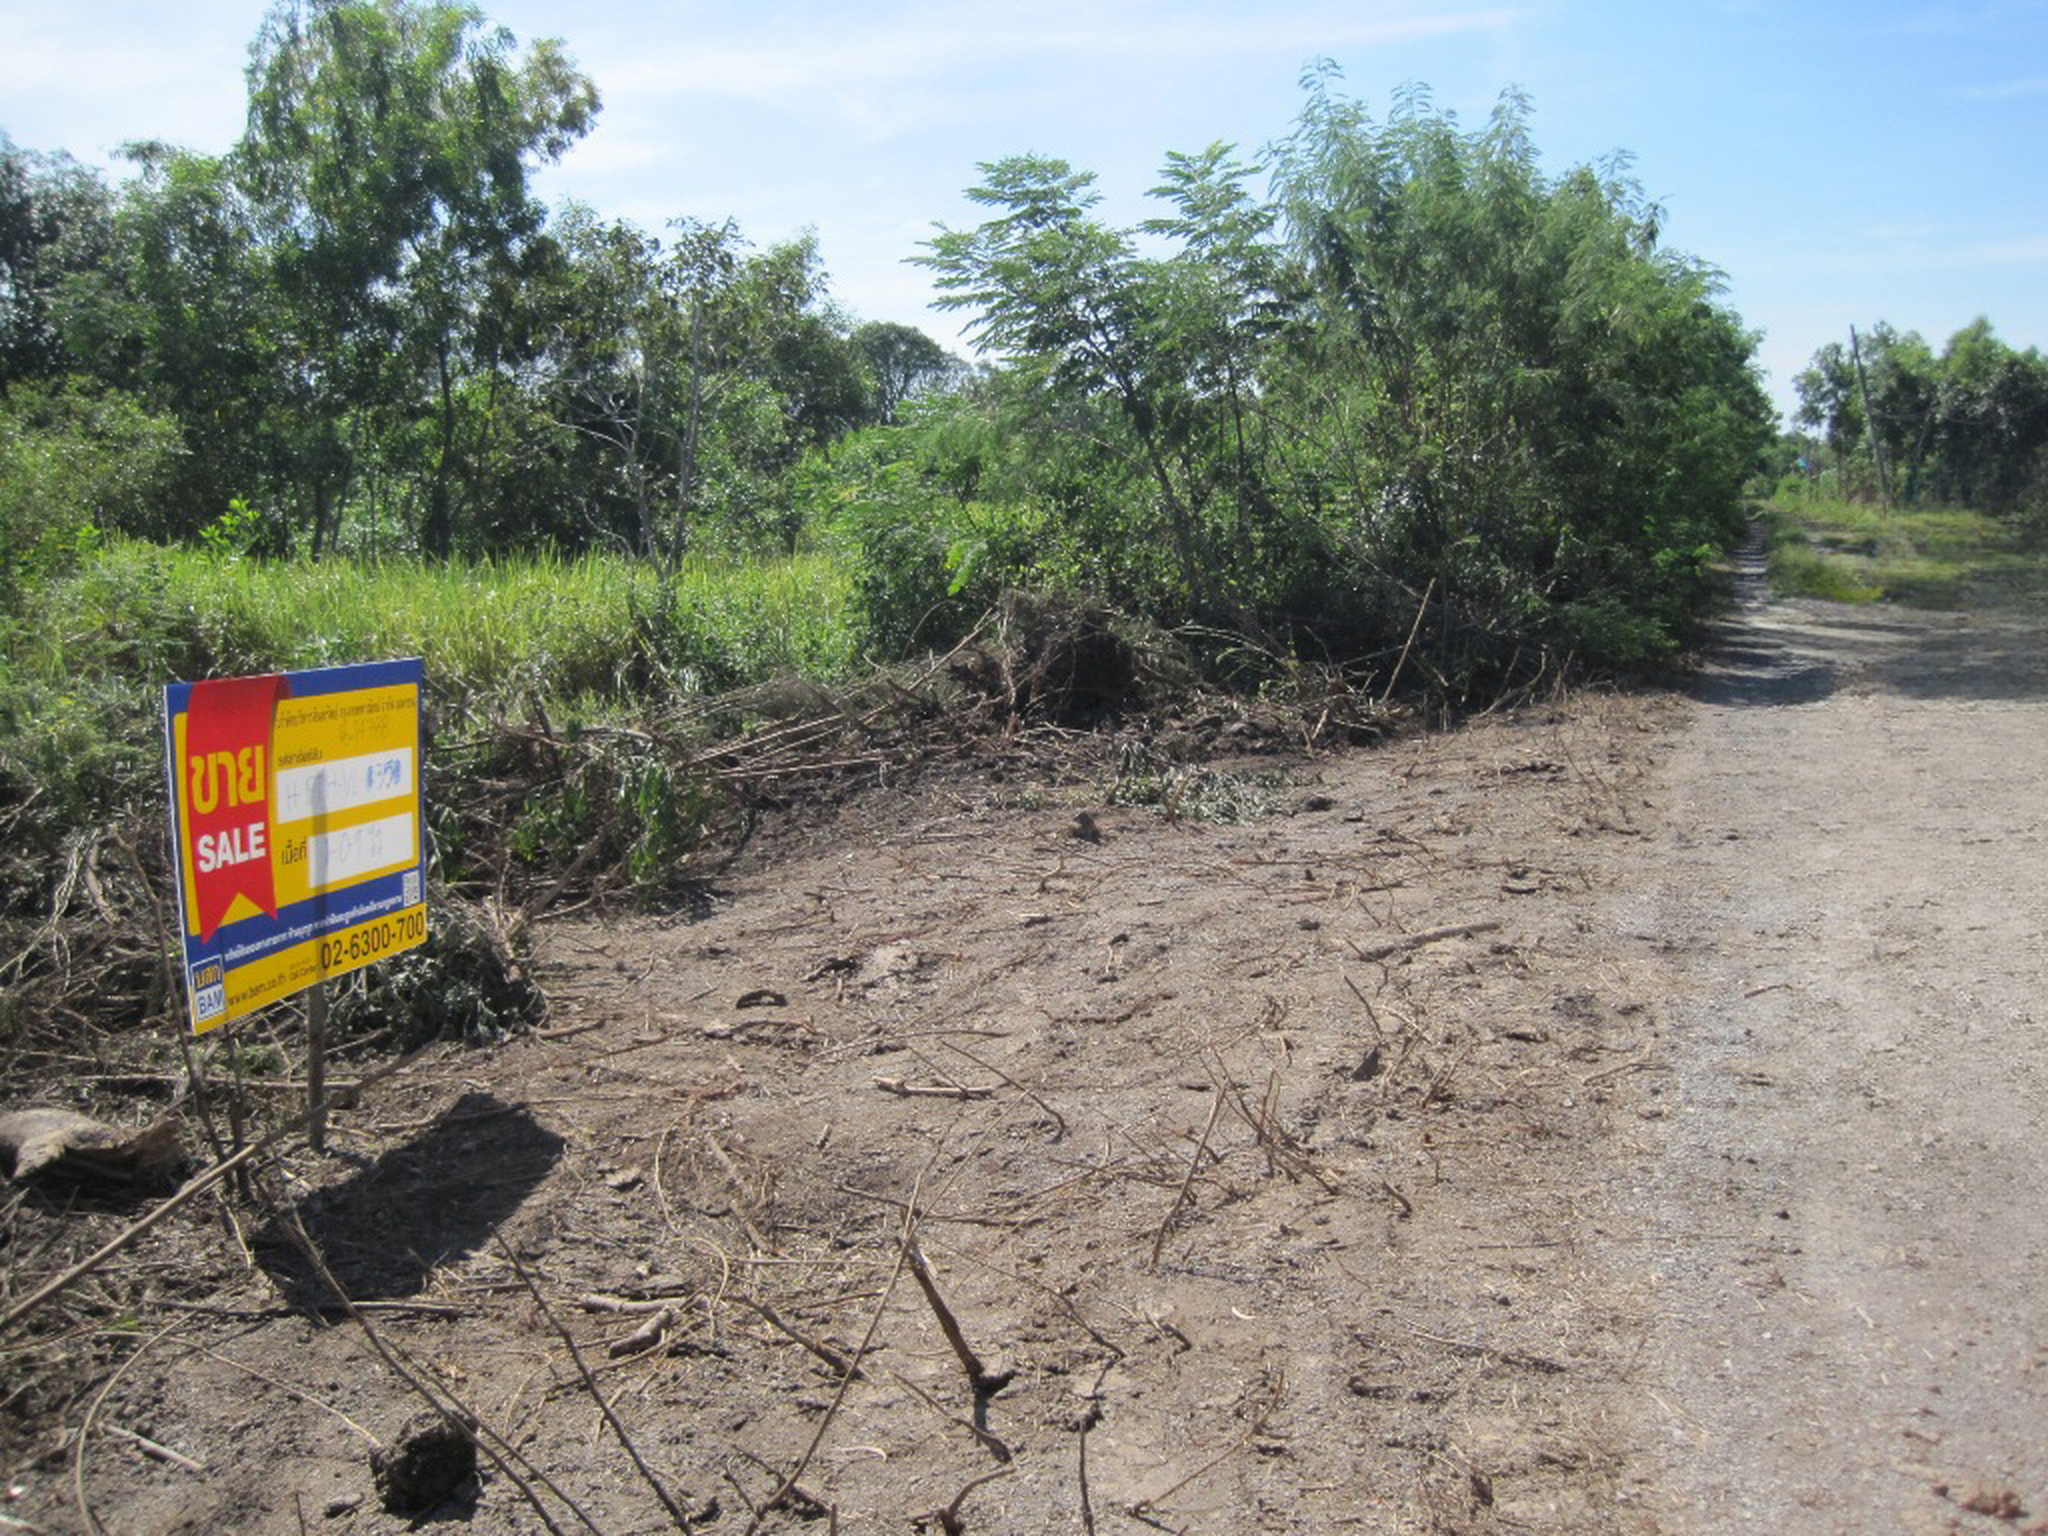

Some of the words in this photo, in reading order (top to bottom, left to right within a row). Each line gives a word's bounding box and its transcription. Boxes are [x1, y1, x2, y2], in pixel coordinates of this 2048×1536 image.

[191, 746, 265, 814] ขาย
[198, 822, 267, 873] SALE
[321, 911, 424, 969] 02-6300-700
[198, 991, 223, 1015] BAM
